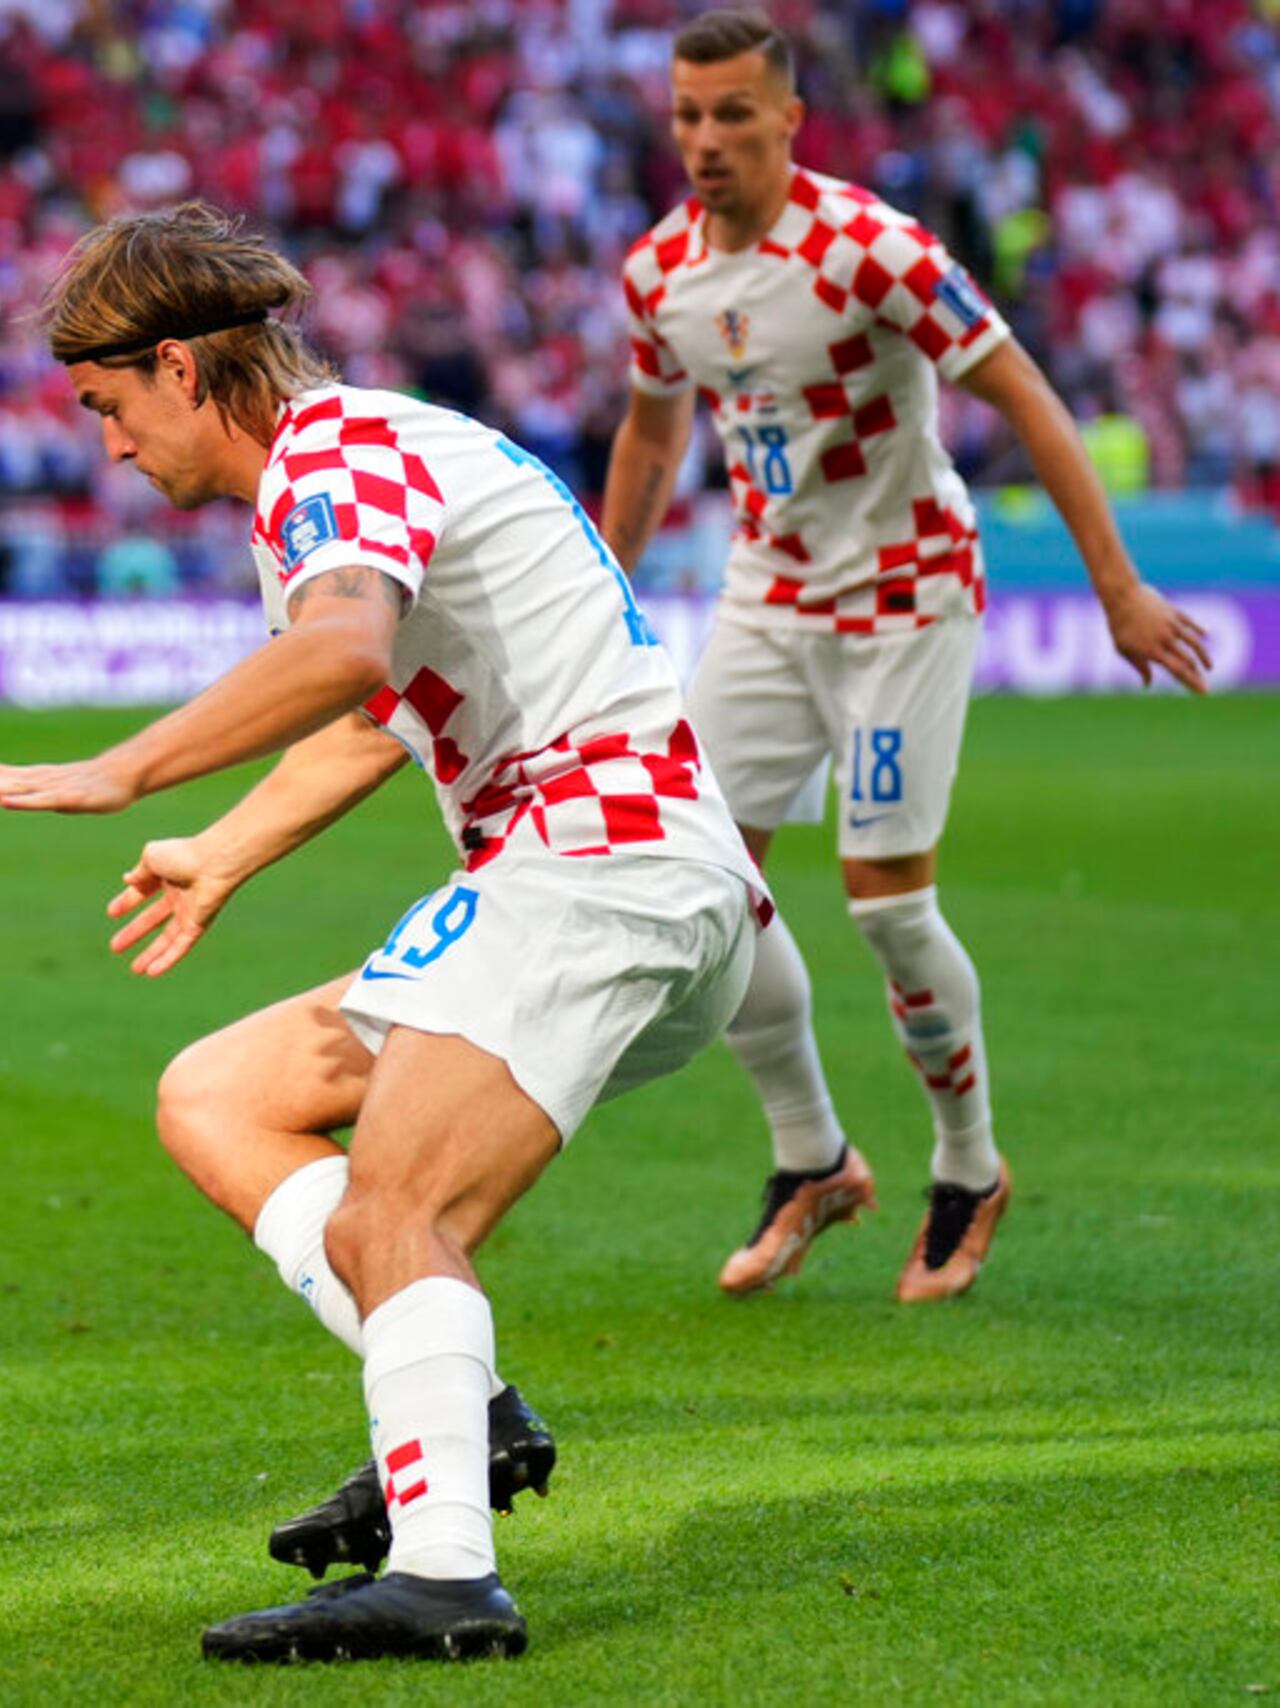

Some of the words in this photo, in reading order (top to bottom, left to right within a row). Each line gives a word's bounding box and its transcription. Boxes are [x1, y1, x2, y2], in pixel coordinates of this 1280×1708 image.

[737, 425, 793, 493] 18
[851, 727, 902, 801] 18
[383, 885, 480, 968] 19
